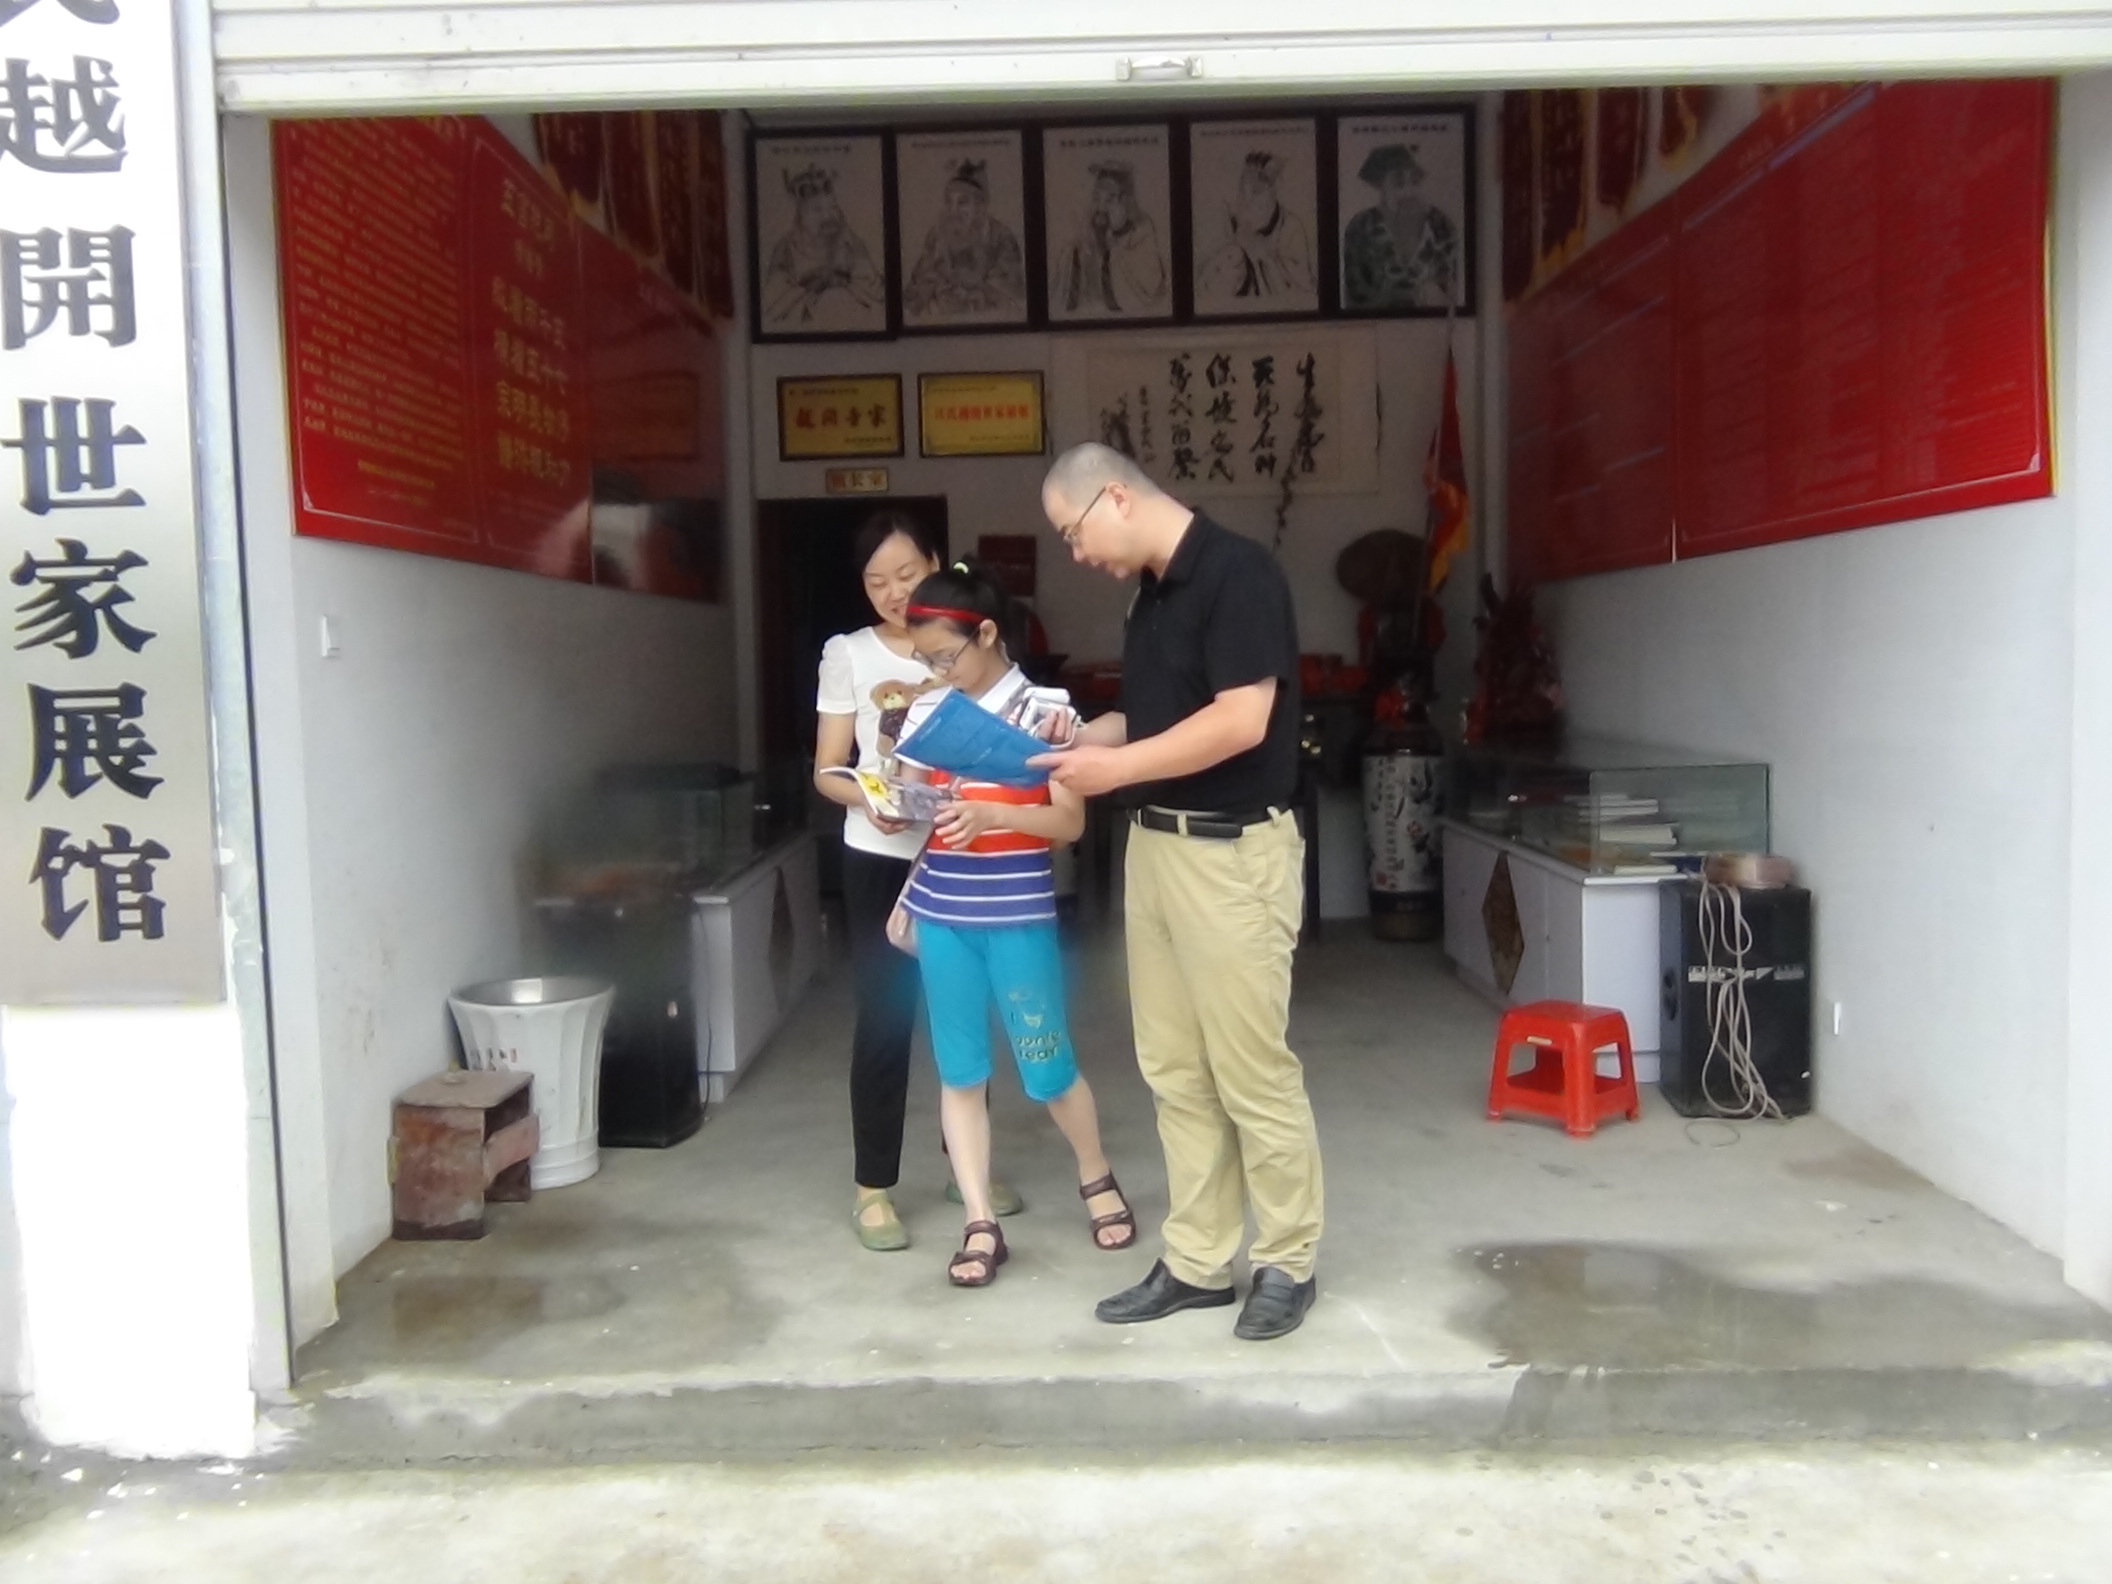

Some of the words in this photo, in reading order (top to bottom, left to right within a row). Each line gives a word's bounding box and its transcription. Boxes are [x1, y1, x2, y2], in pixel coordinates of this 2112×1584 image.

[0, 0, 172, 943] 越開世家展馆
